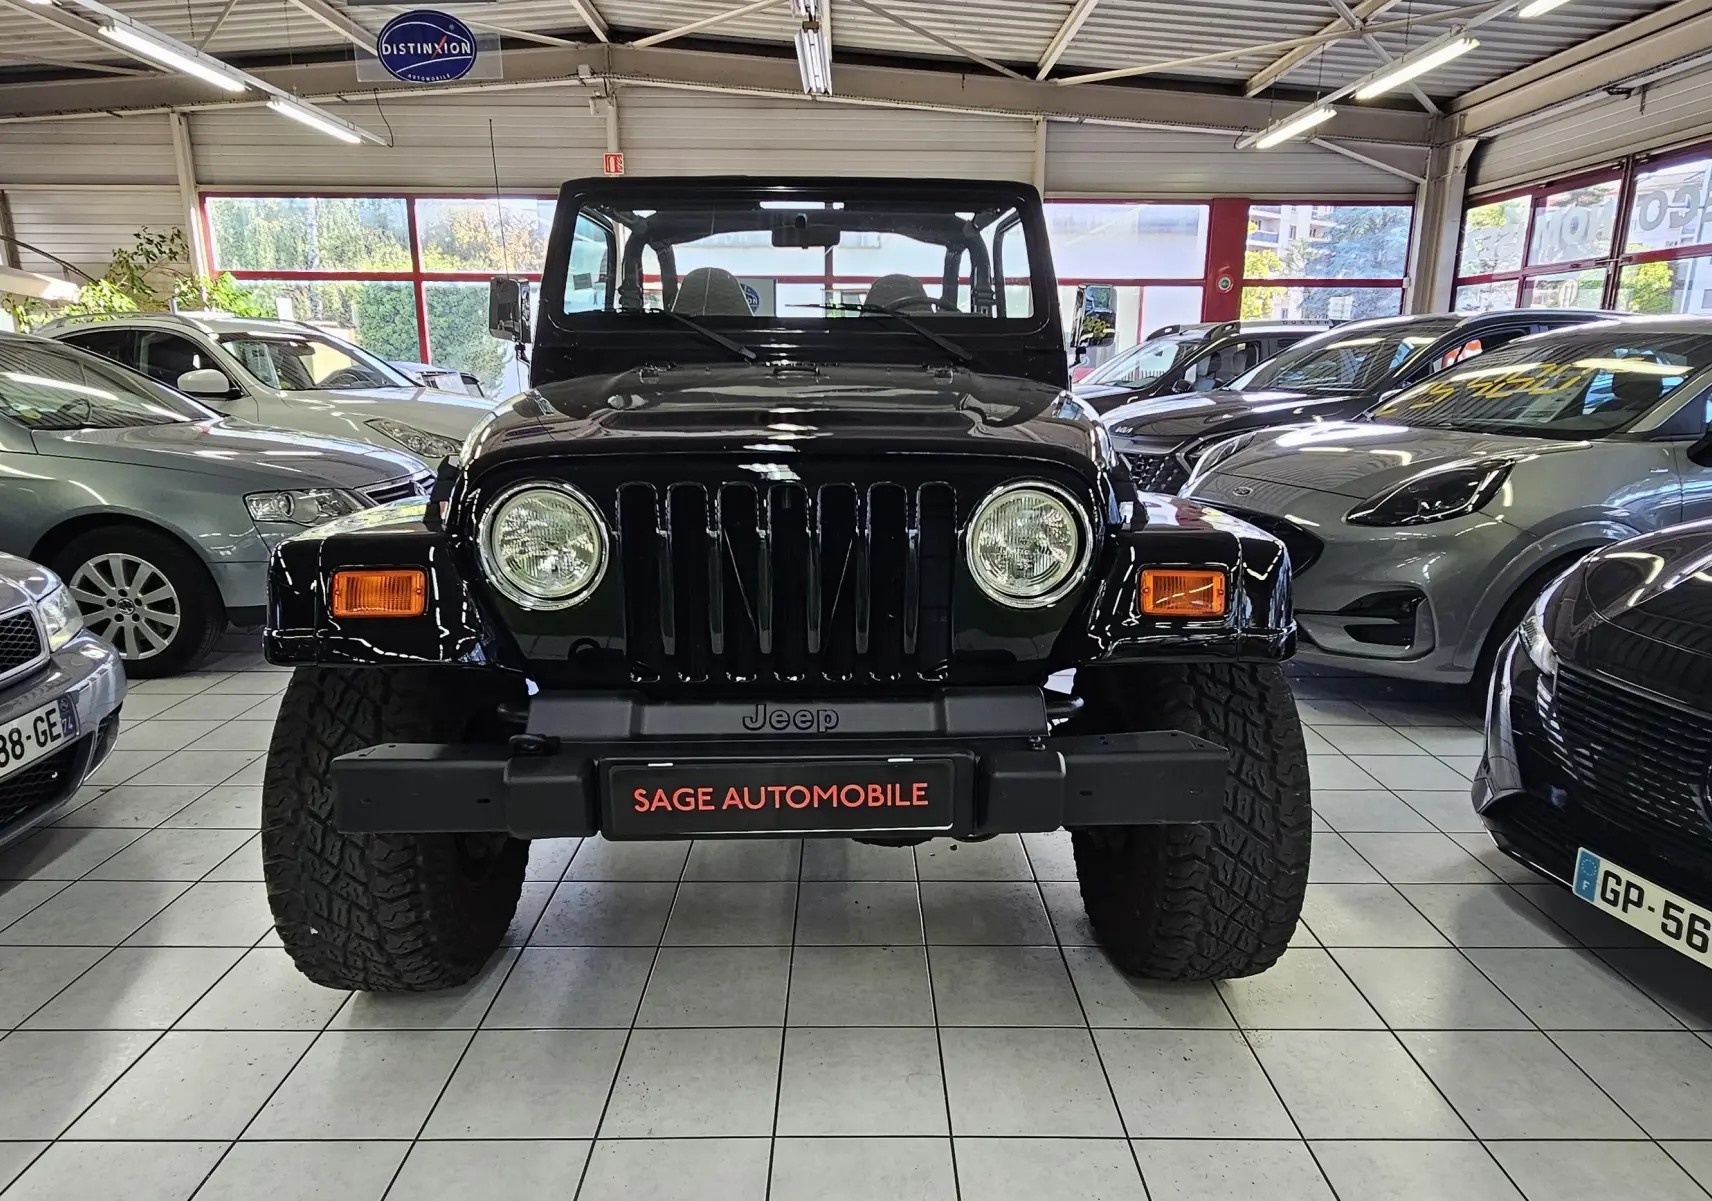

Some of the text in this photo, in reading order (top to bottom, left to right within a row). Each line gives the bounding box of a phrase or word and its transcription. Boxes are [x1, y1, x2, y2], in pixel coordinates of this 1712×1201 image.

[382, 40, 471, 57] DISTINXION
[742, 704, 839, 733] Jeep
[633, 782, 929, 812] SAGE AUTOMOBILE
[1582, 880, 1590, 890] F
[1600, 869, 1712, 954] GP-56
